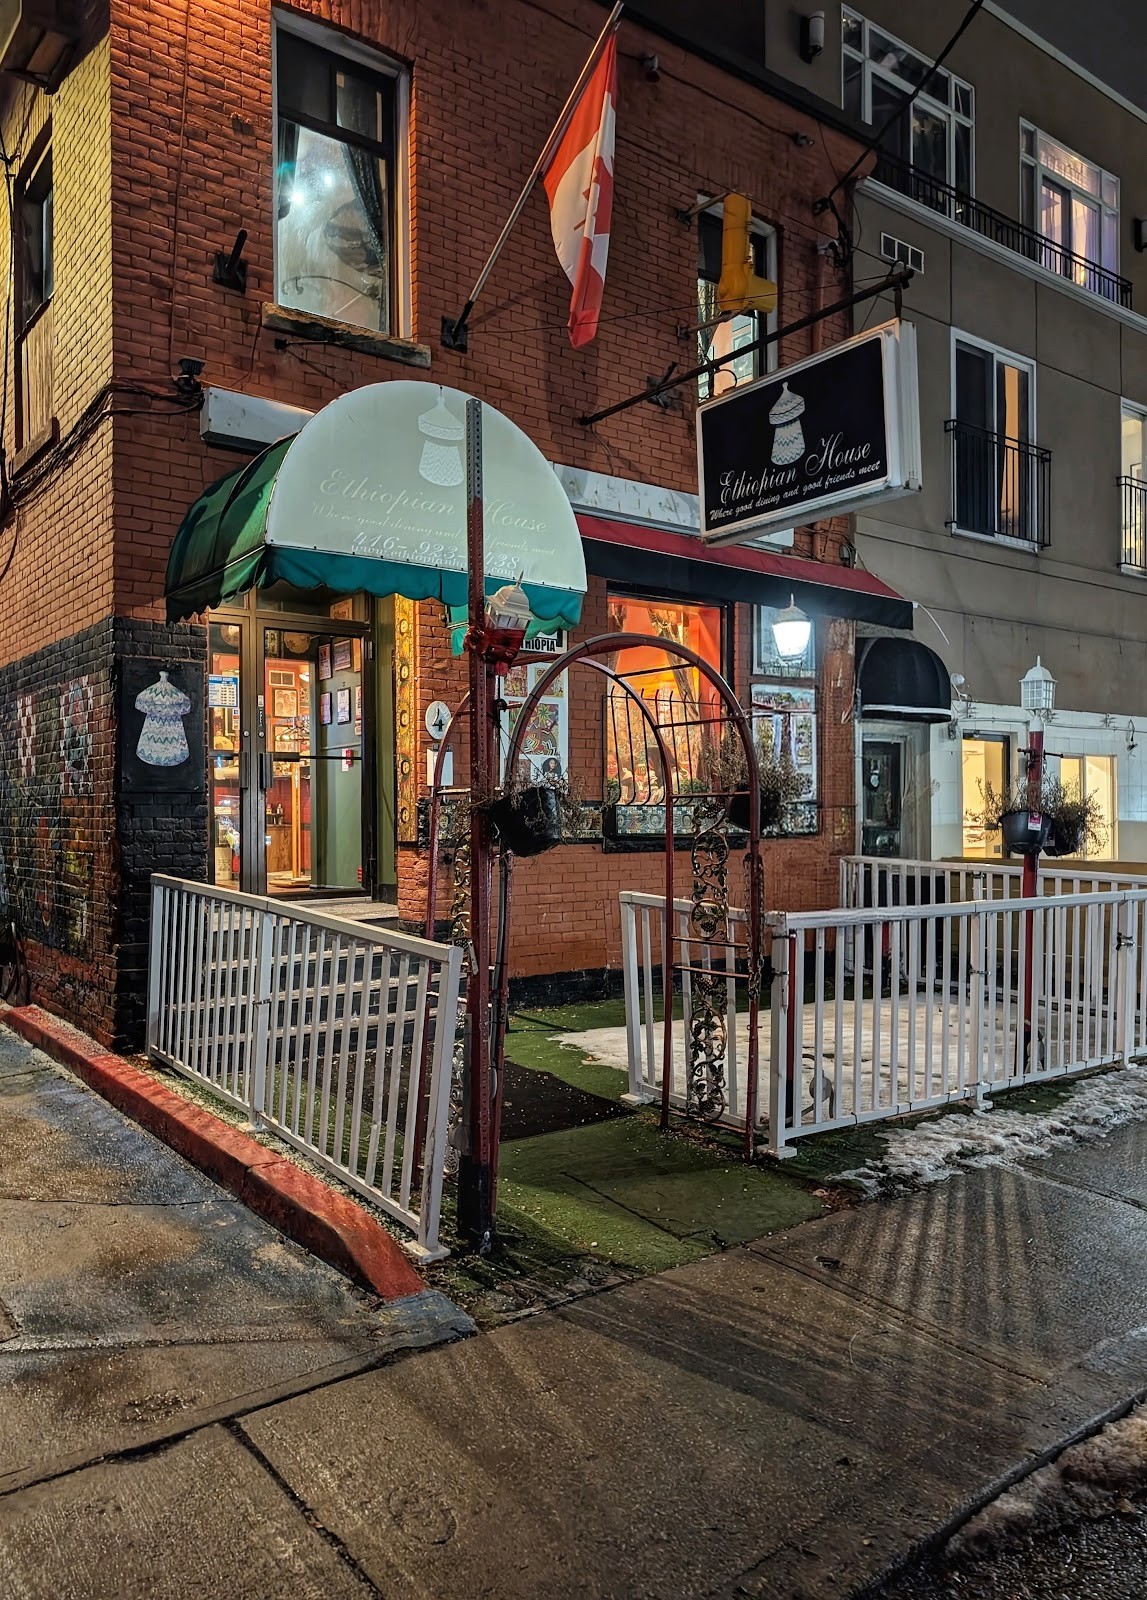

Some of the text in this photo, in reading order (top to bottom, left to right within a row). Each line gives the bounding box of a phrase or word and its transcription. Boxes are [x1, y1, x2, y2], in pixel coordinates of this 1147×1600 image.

[720, 431, 871, 506] Ethiopian House
[320, 468, 456, 515] Ethiopian
[709, 460, 881, 521] Where good dining and good friends meet
[351, 544, 514, 576] www.ethiopianho.com
[483, 551, 520, 570] 438
[432, 708, 446, 732] 4
